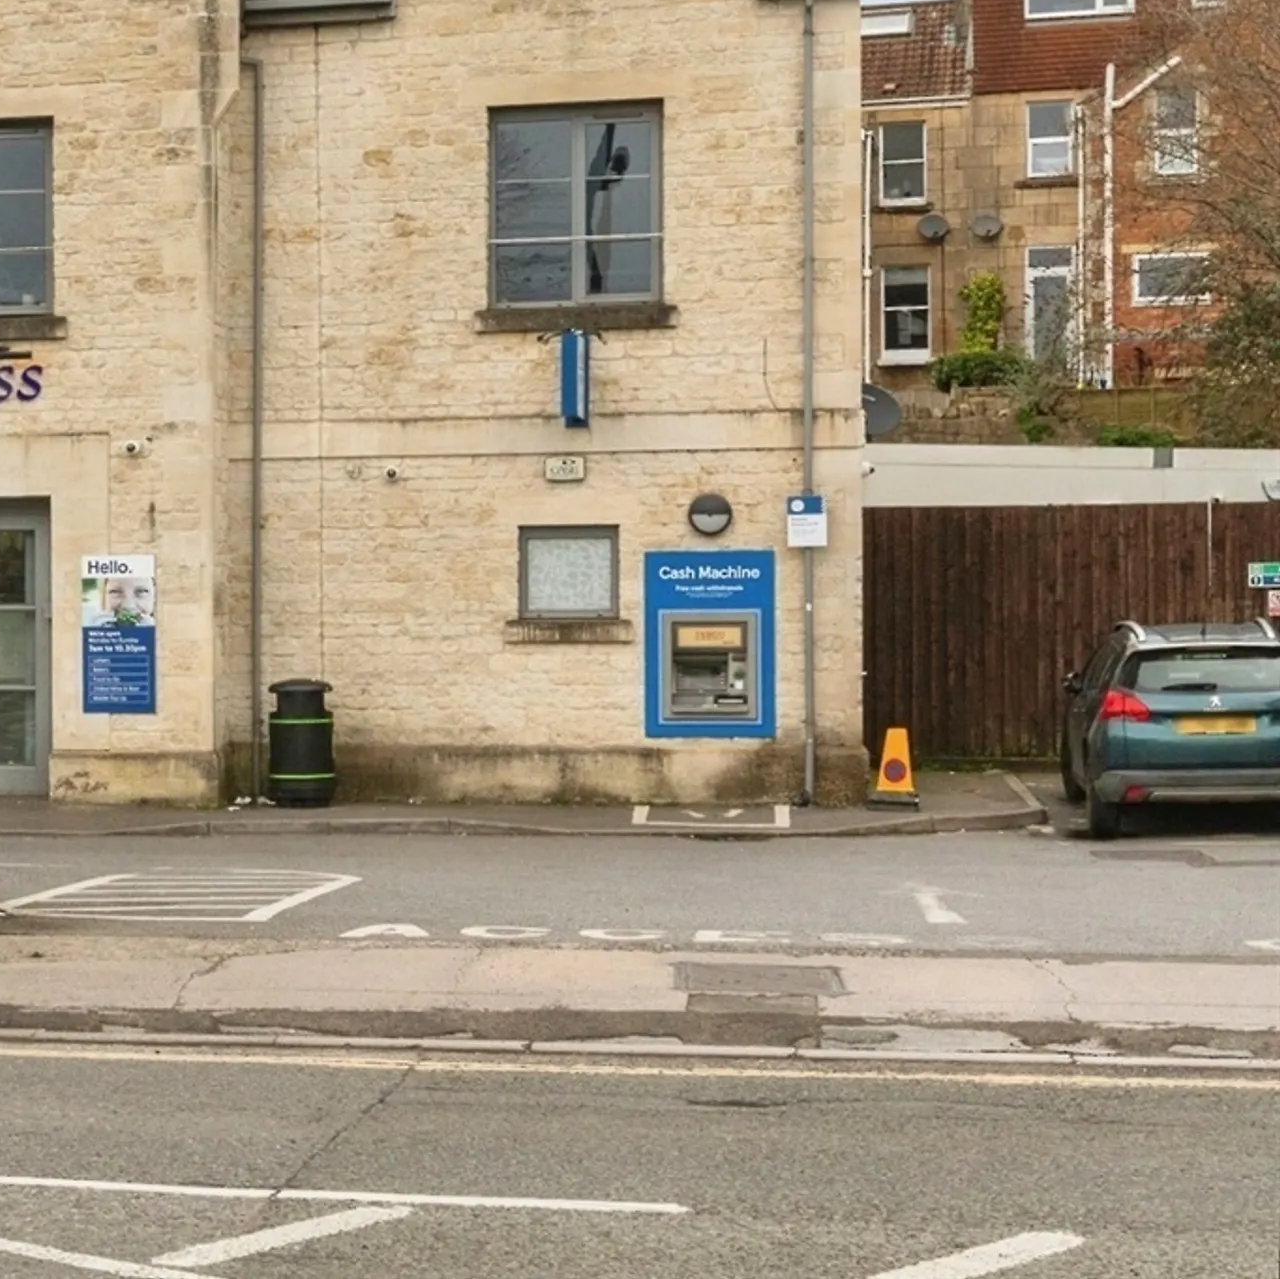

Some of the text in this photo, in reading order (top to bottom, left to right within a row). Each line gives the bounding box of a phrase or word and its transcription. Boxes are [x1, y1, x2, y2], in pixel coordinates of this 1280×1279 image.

[87, 560, 133, 574] Hello.
[659, 565, 761, 579] Cash Machine
